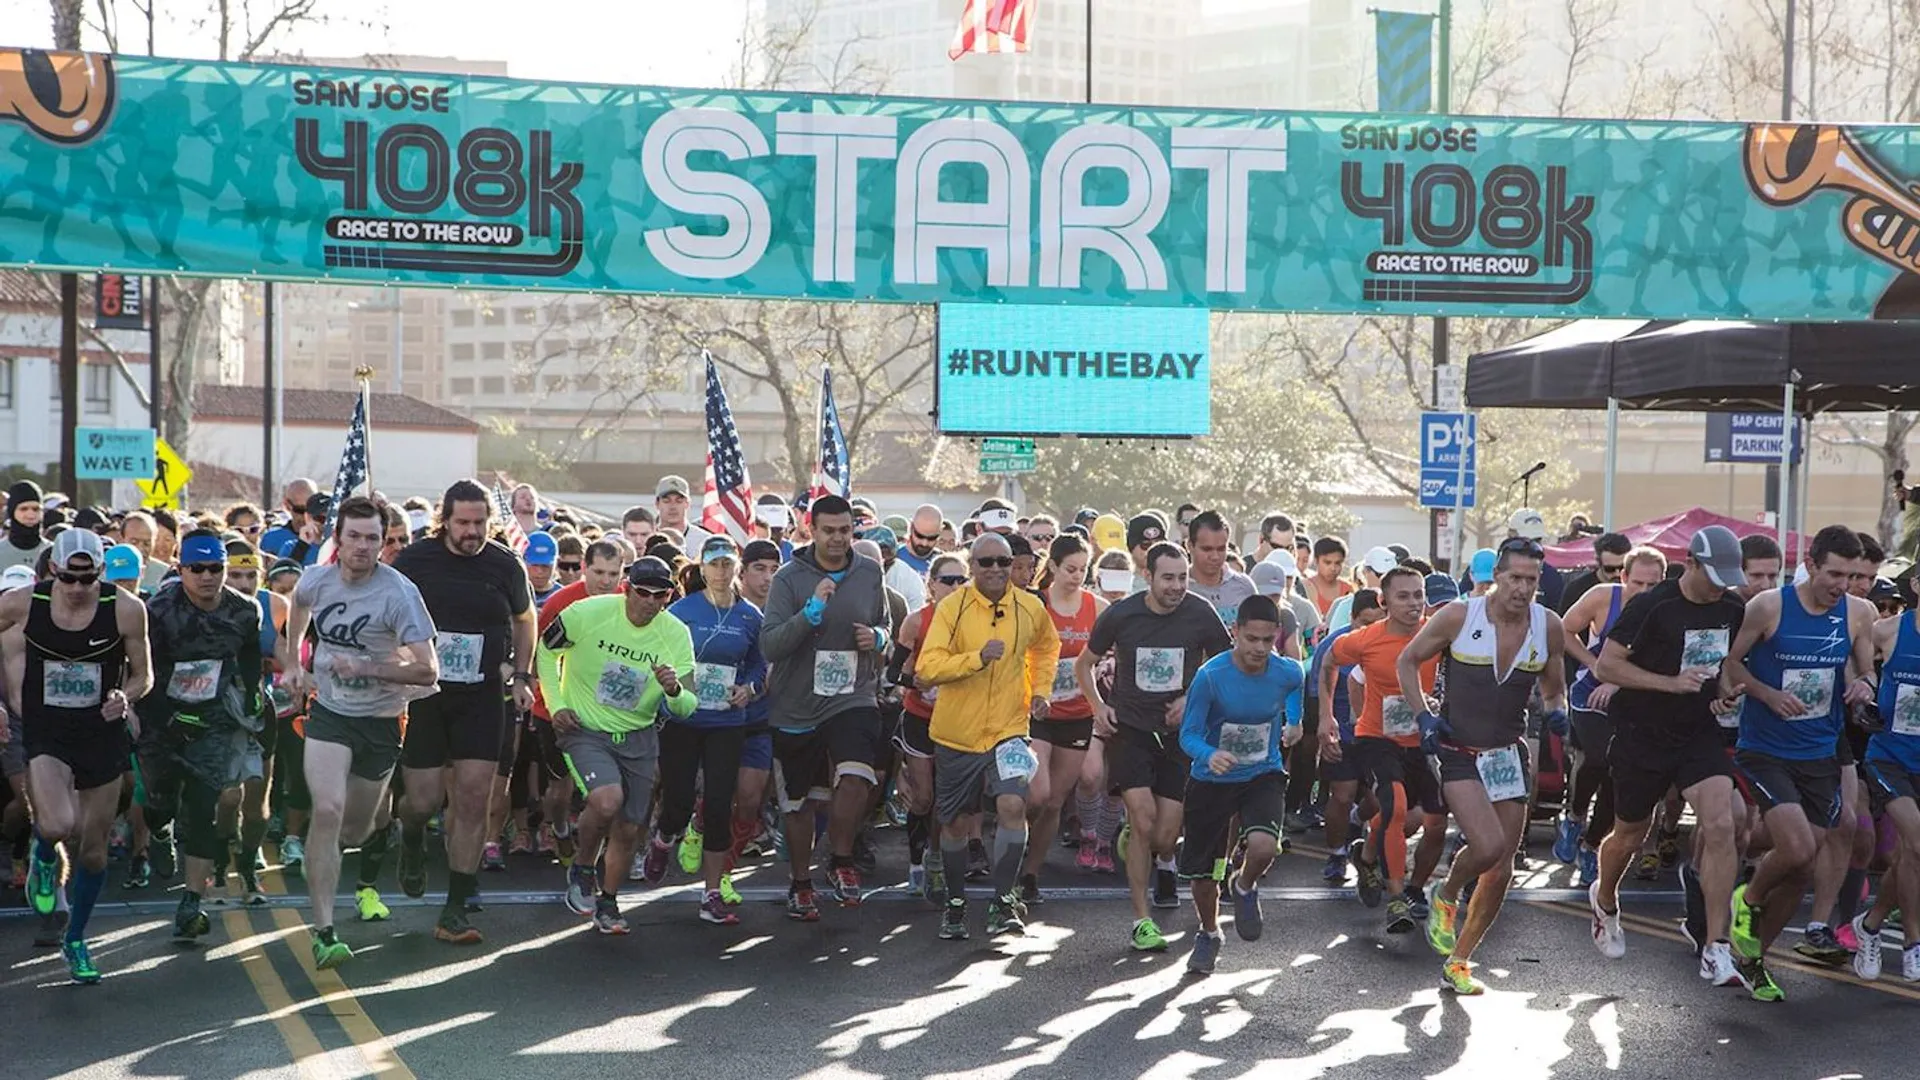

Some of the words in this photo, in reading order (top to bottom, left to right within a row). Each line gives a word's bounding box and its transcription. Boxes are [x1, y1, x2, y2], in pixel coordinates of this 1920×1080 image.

[293, 79, 360, 108] SAN
[367, 83, 449, 113] JOSE
[1341, 125, 1398, 151] SAN
[1404, 127, 1477, 153] JOSE
[642, 107, 1287, 292] START
[337, 219, 389, 239] RACE
[391, 222, 420, 240] TO
[422, 224, 460, 242] THE
[463, 225, 512, 244] ROW
[1376, 255, 1421, 272] RACE
[1422, 256, 1447, 273] TO
[1449, 256, 1484, 274] THE
[1485, 257, 1529, 275] ROW
[947, 349, 1204, 380] #RUNTHEBAY
[1732, 415, 1753, 427] SAP
[1754, 415, 1797, 428] CENTR
[82, 456, 133, 471] WAVE
[140, 457, 147, 471] 1
[316, 602, 371, 650] Cal
[615, 645, 658, 663] RUN
[1774, 651, 1818, 662] LOCKHEED
